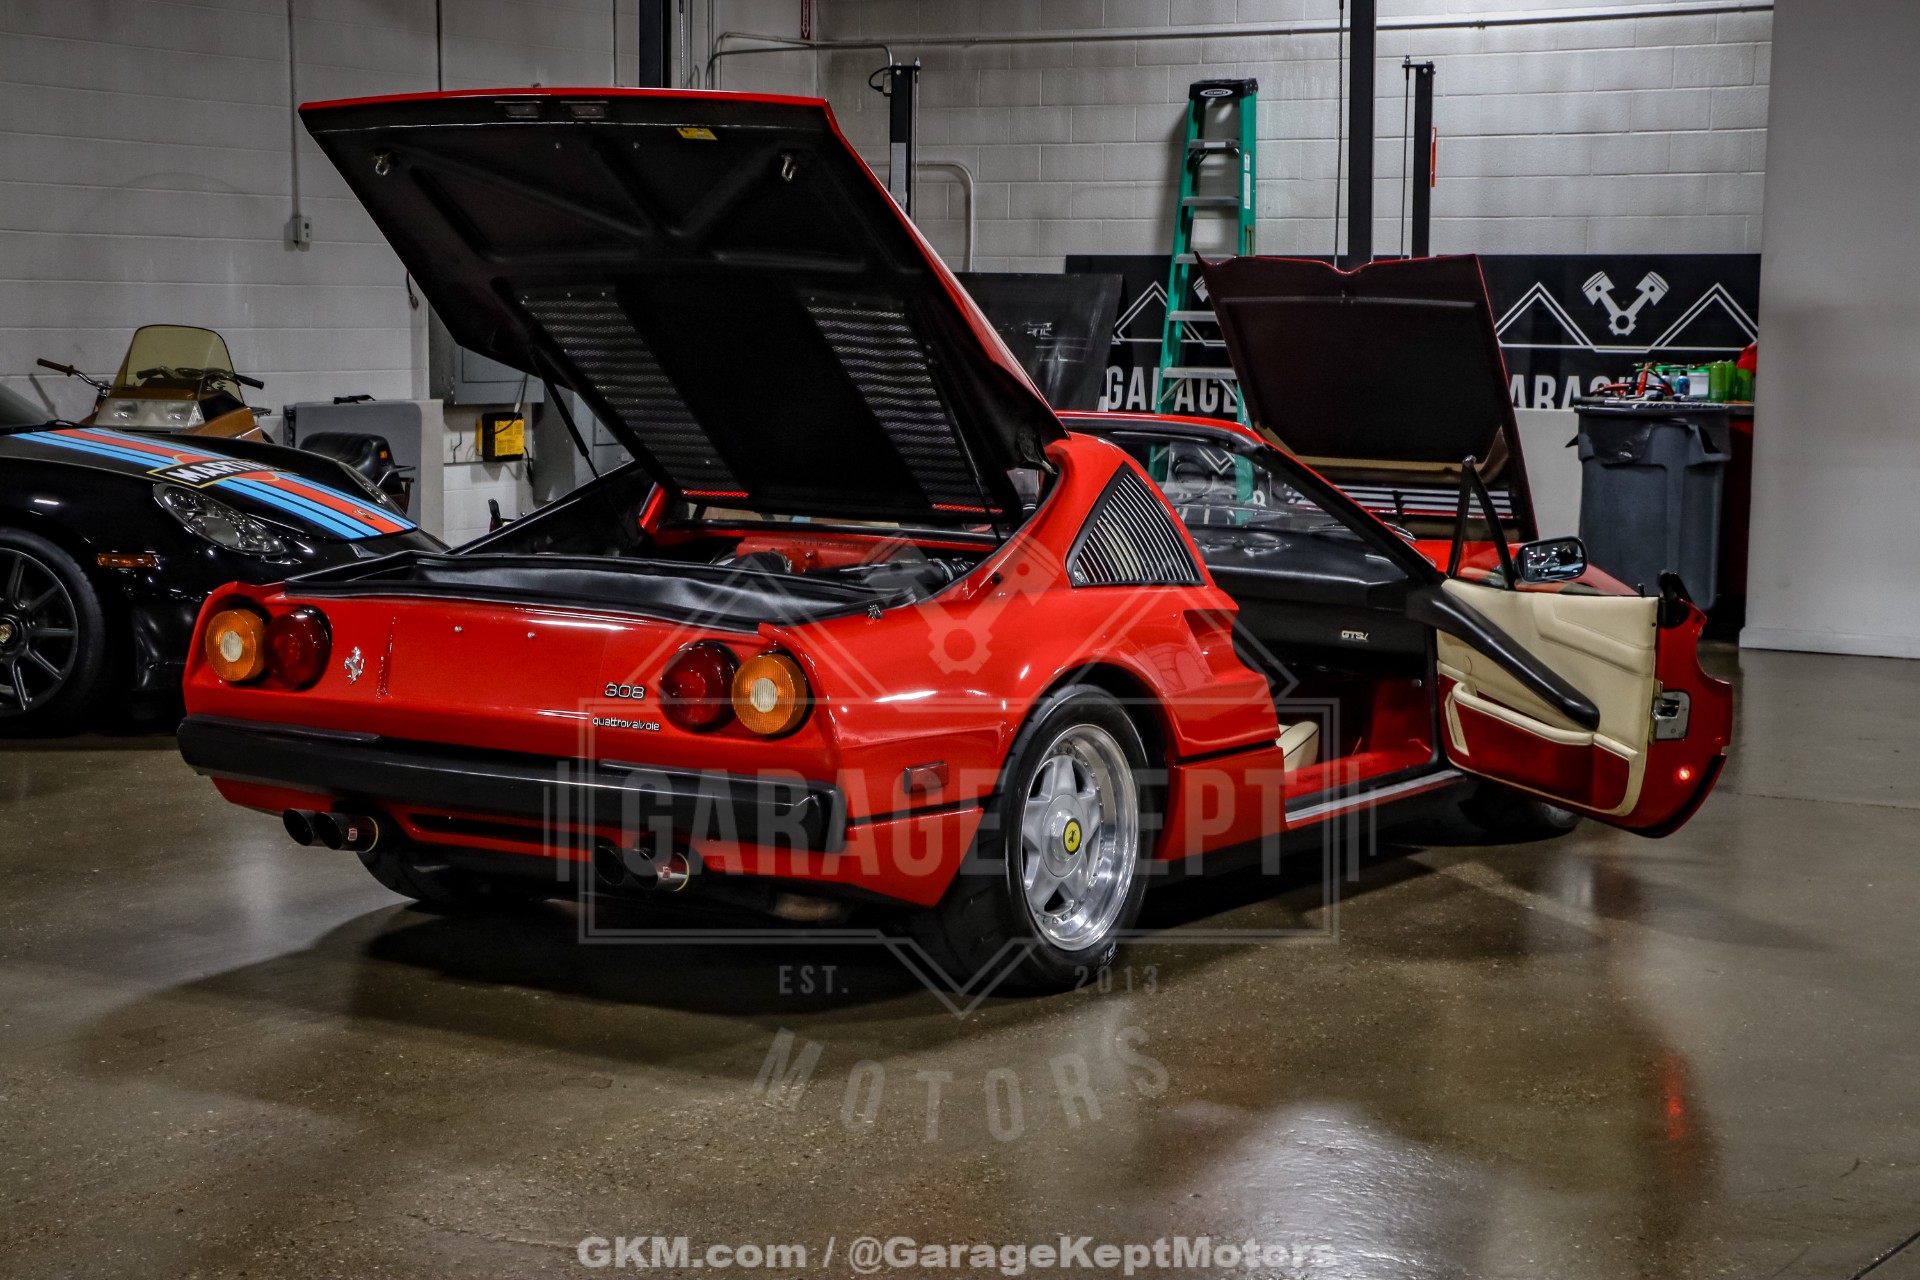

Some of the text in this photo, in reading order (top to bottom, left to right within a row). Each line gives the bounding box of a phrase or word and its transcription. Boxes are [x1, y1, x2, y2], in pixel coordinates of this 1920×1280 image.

[1106, 365, 1237, 414] GAAG
[1509, 374, 1632, 409] ARA
[604, 682, 645, 699] 308
